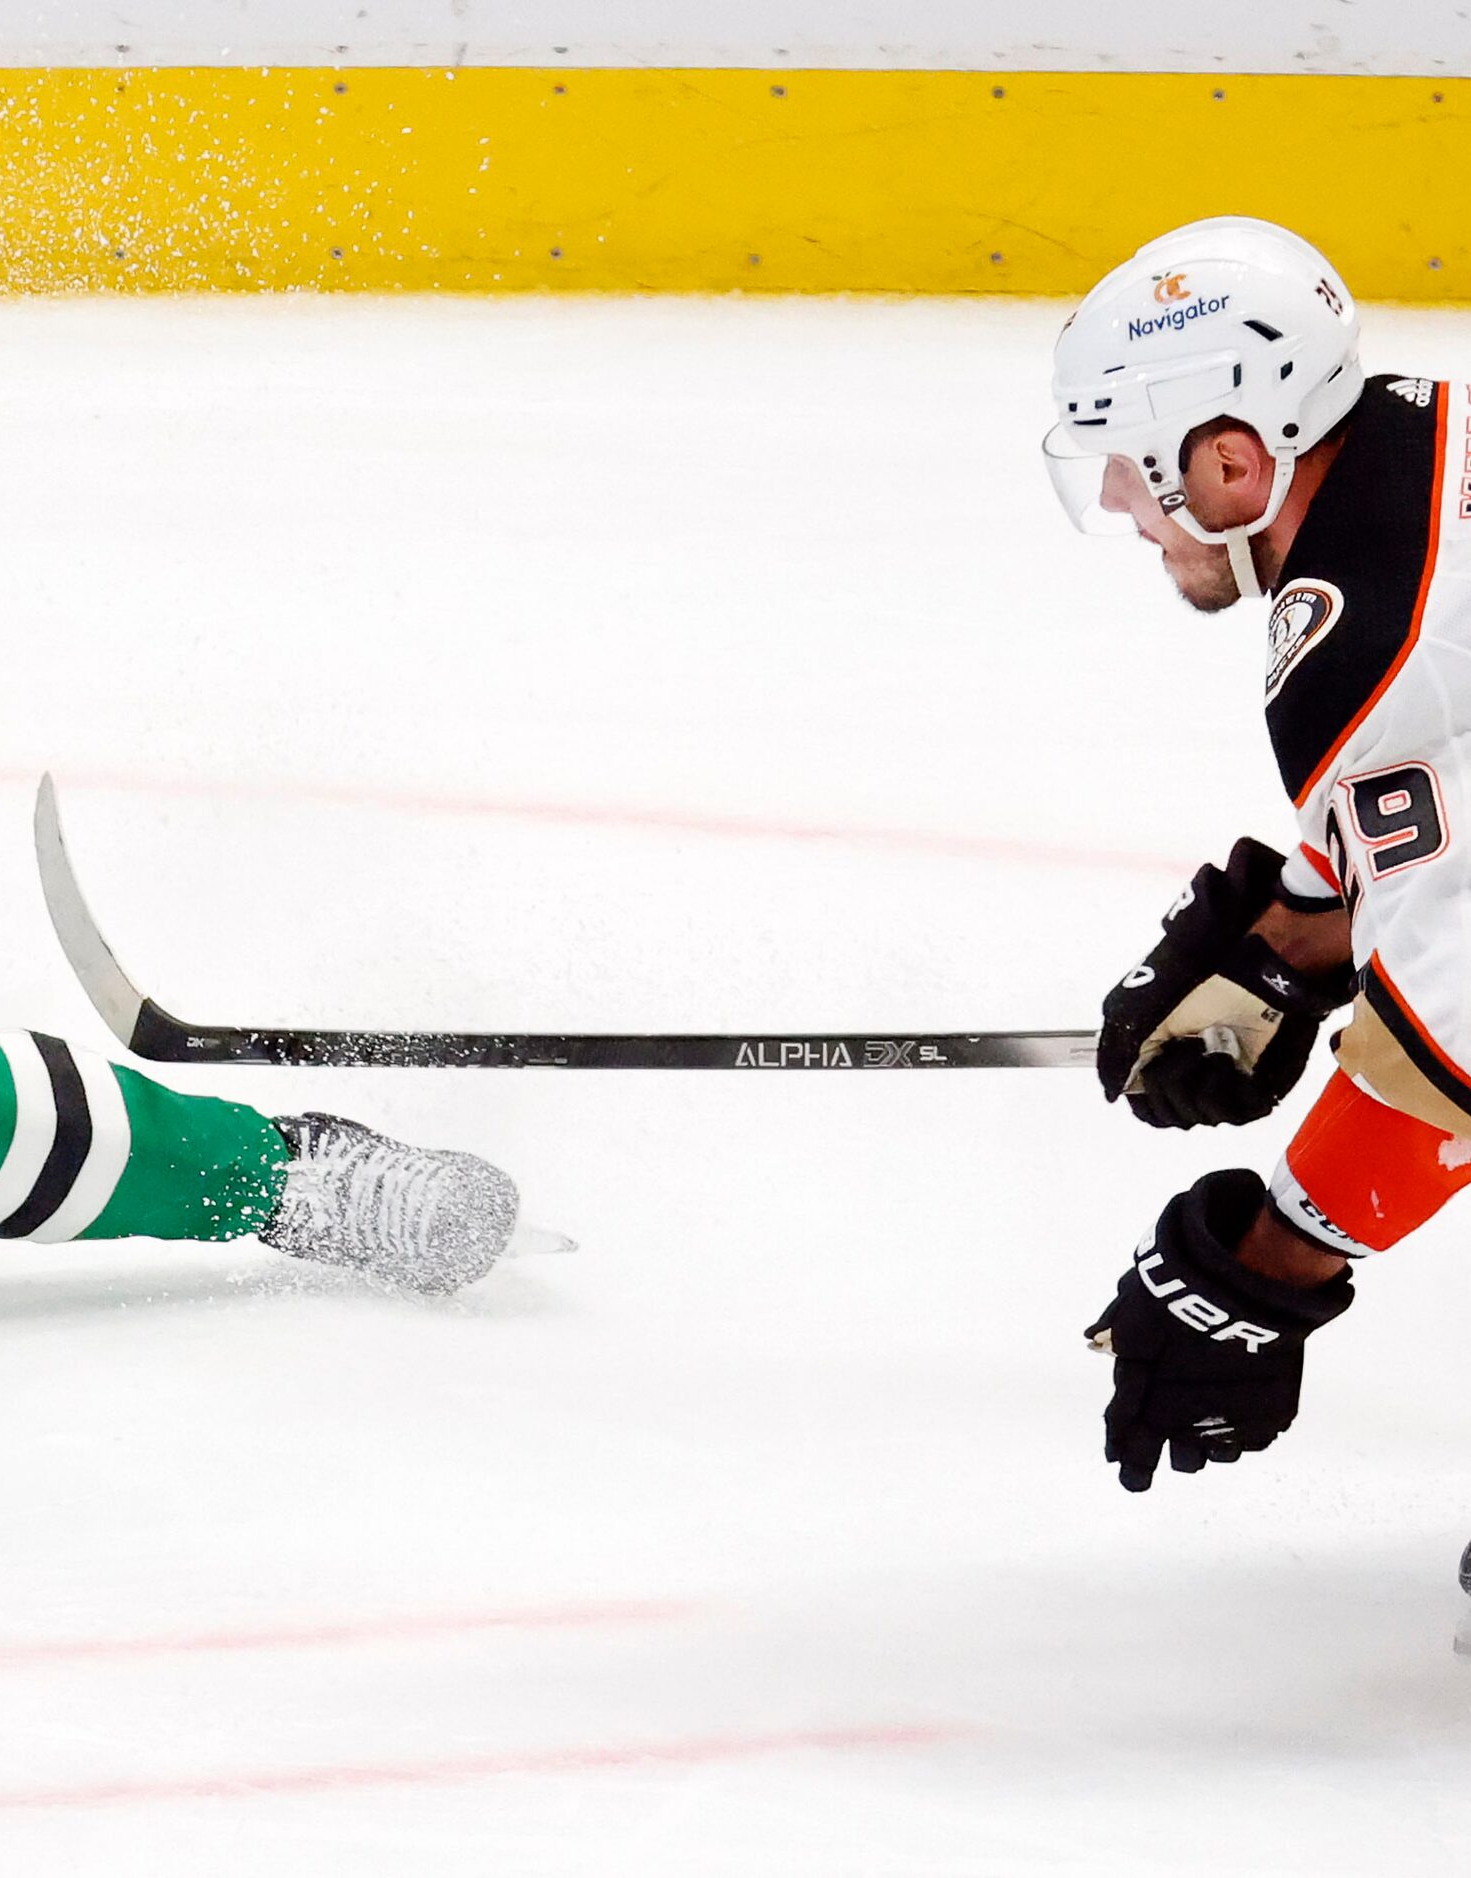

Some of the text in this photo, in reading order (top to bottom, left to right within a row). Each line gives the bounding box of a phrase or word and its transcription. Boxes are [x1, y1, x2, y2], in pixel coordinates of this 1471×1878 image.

[1128, 294, 1230, 341] Navigator
[734, 1042, 853, 1067] ALPHA
[919, 1045, 948, 1061] SL
